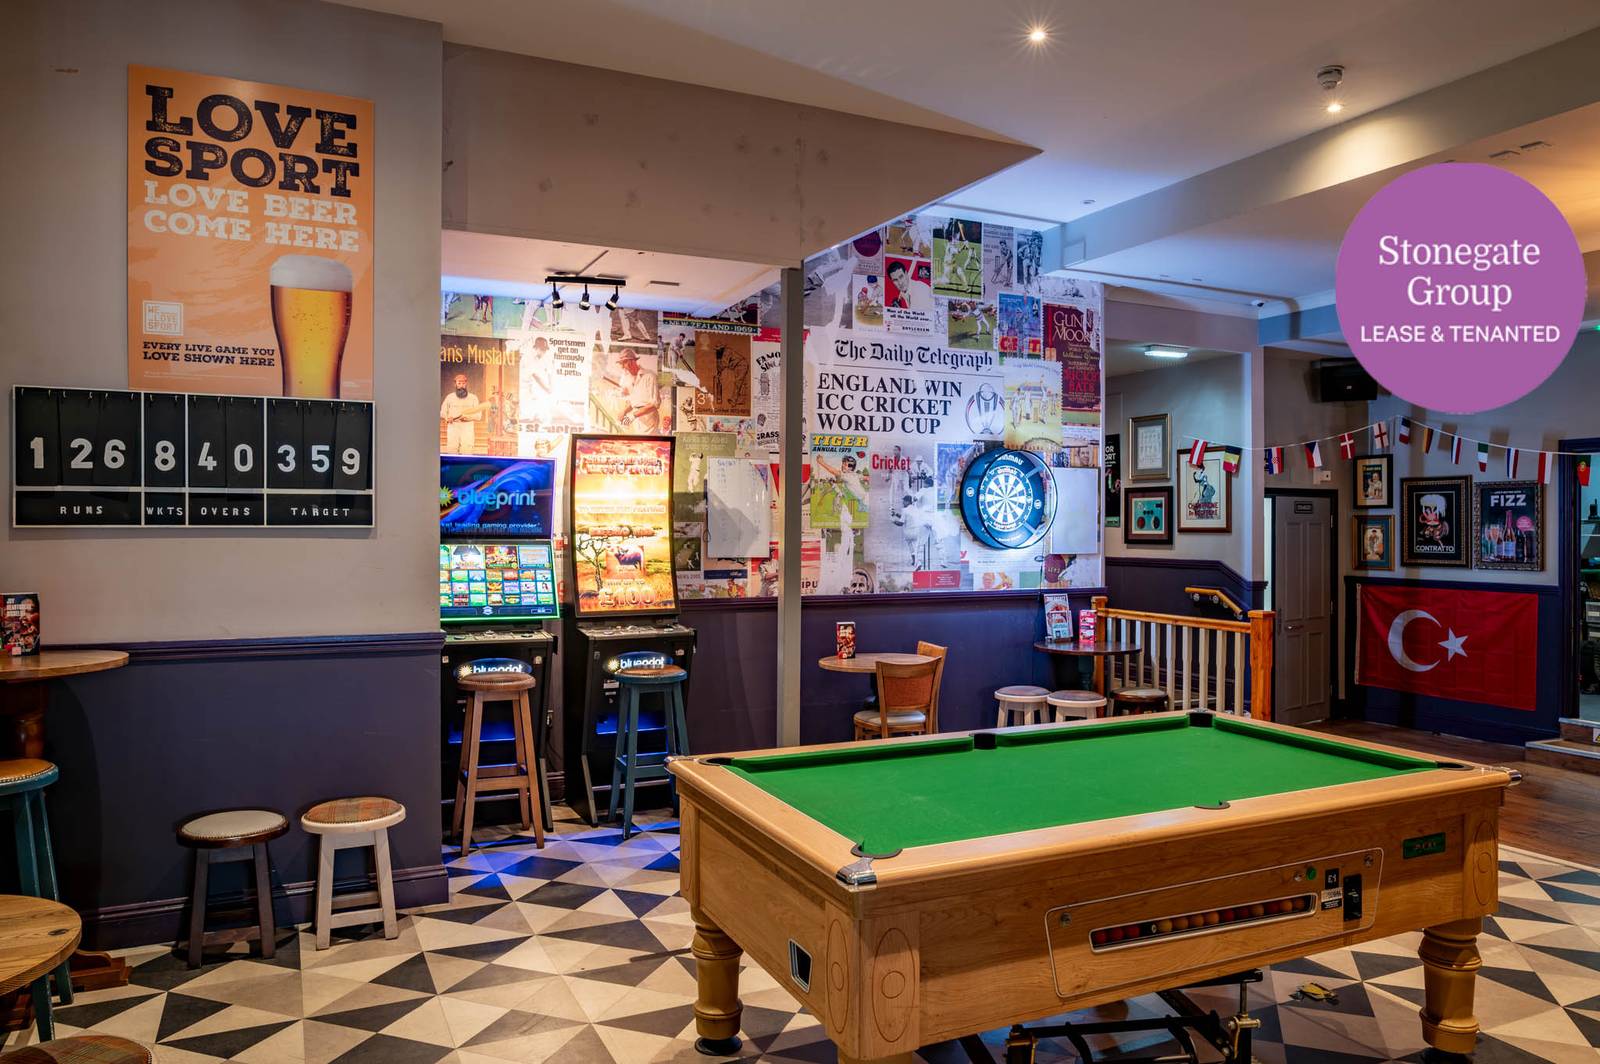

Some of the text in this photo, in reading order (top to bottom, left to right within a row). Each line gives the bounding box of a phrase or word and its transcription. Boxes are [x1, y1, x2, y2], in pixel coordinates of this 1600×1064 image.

[145, 84, 358, 159] LOVE
[145, 136, 359, 198] SPORT
[144, 180, 358, 226] LOVE BEER
[144, 210, 359, 252] COME HERE
[154, 312, 177, 322] LOVE
[148, 321, 178, 331] SPORT
[691, 321, 730, 330] ZEALAND
[143, 341, 275, 356] EVERY LIVE GAME YOU
[549, 338, 585, 347] Sportsmen
[143, 351, 275, 367] LOVE SHOWN HERE
[440, 344, 515, 366] an's Mustard
[756, 351, 781, 365] FAMO
[835, 339, 993, 371] The Daily Telegraph
[817, 373, 962, 397] ENGLAND WIN
[817, 393, 952, 416] ICC CRICKET
[817, 413, 941, 434] WORLD CUP
[812, 435, 869, 448] TIGER
[154, 440, 176, 472] 8
[872, 454, 911, 471] Cricket
[1104, 452, 1117, 461] ORT
[457, 489, 537, 509] blueprint
[1490, 494, 1527, 507] FIZZ
[60, 505, 103, 515] RUNS
[146, 506, 184, 516] WKTS
[200, 507, 251, 516] OVERS
[290, 507, 350, 517] TARGET
